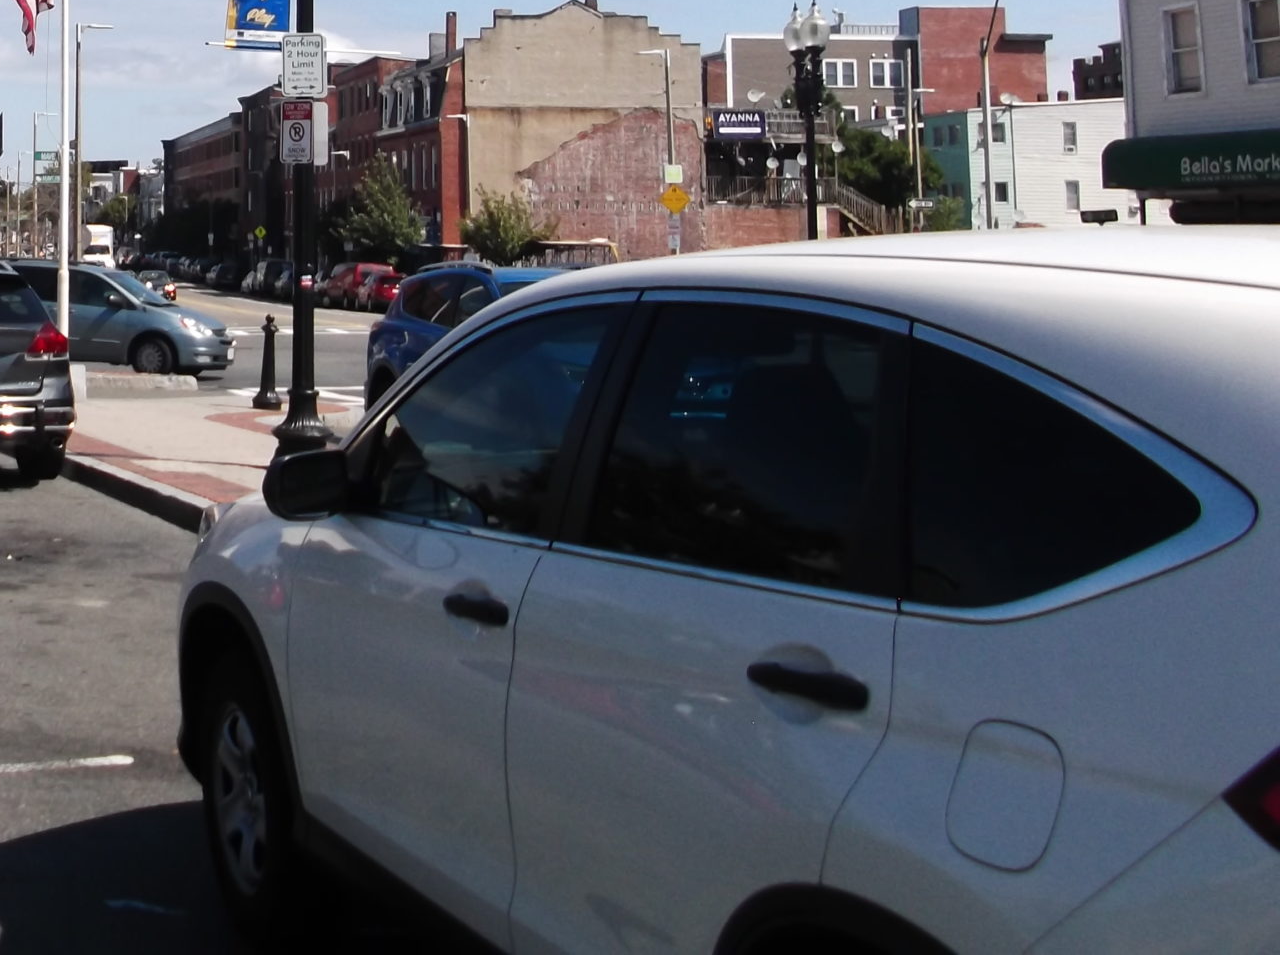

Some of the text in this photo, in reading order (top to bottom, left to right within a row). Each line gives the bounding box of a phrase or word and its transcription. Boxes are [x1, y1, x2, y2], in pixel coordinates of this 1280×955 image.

[285, 40, 321, 49] Parking
[287, 50, 319, 59] 2 Hour
[291, 61, 315, 69] Limit
[718, 112, 761, 123] AYANNA
[1181, 155, 1232, 175] Bella's
